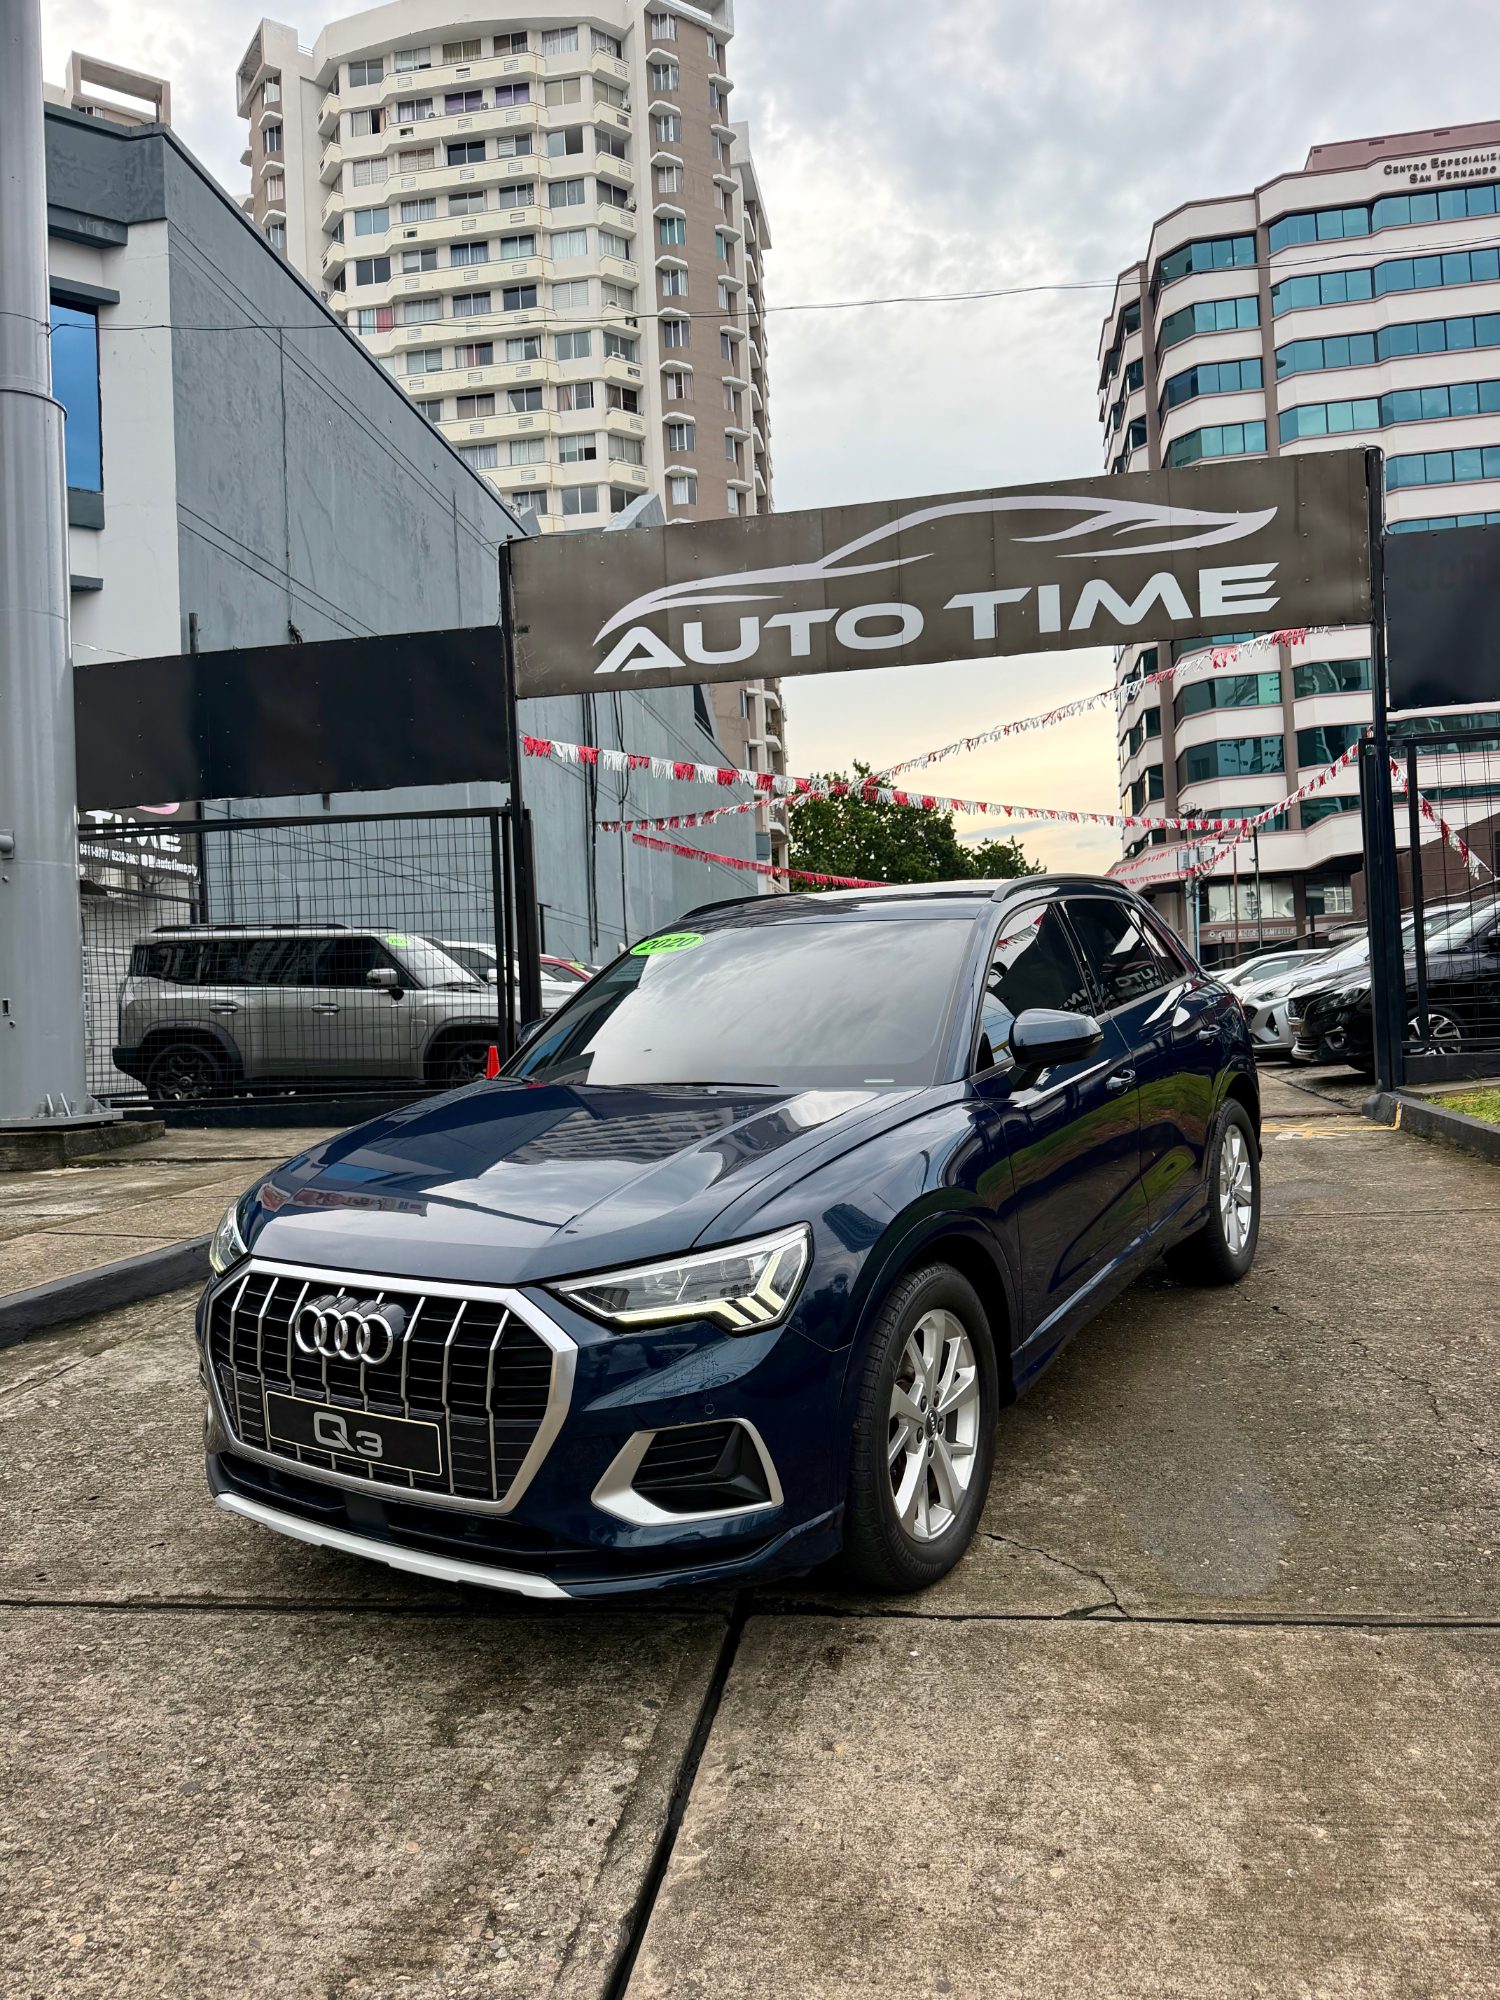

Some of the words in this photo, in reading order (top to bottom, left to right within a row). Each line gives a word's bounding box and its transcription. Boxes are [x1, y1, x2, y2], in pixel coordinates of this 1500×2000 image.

[1431, 153, 1500, 169] ESPECIALIZ
[594, 602, 923, 673] AUTO
[943, 562, 1280, 639] TIME
[636, 937, 699, 952] 2020
[314, 1411, 383, 1457] Q3
